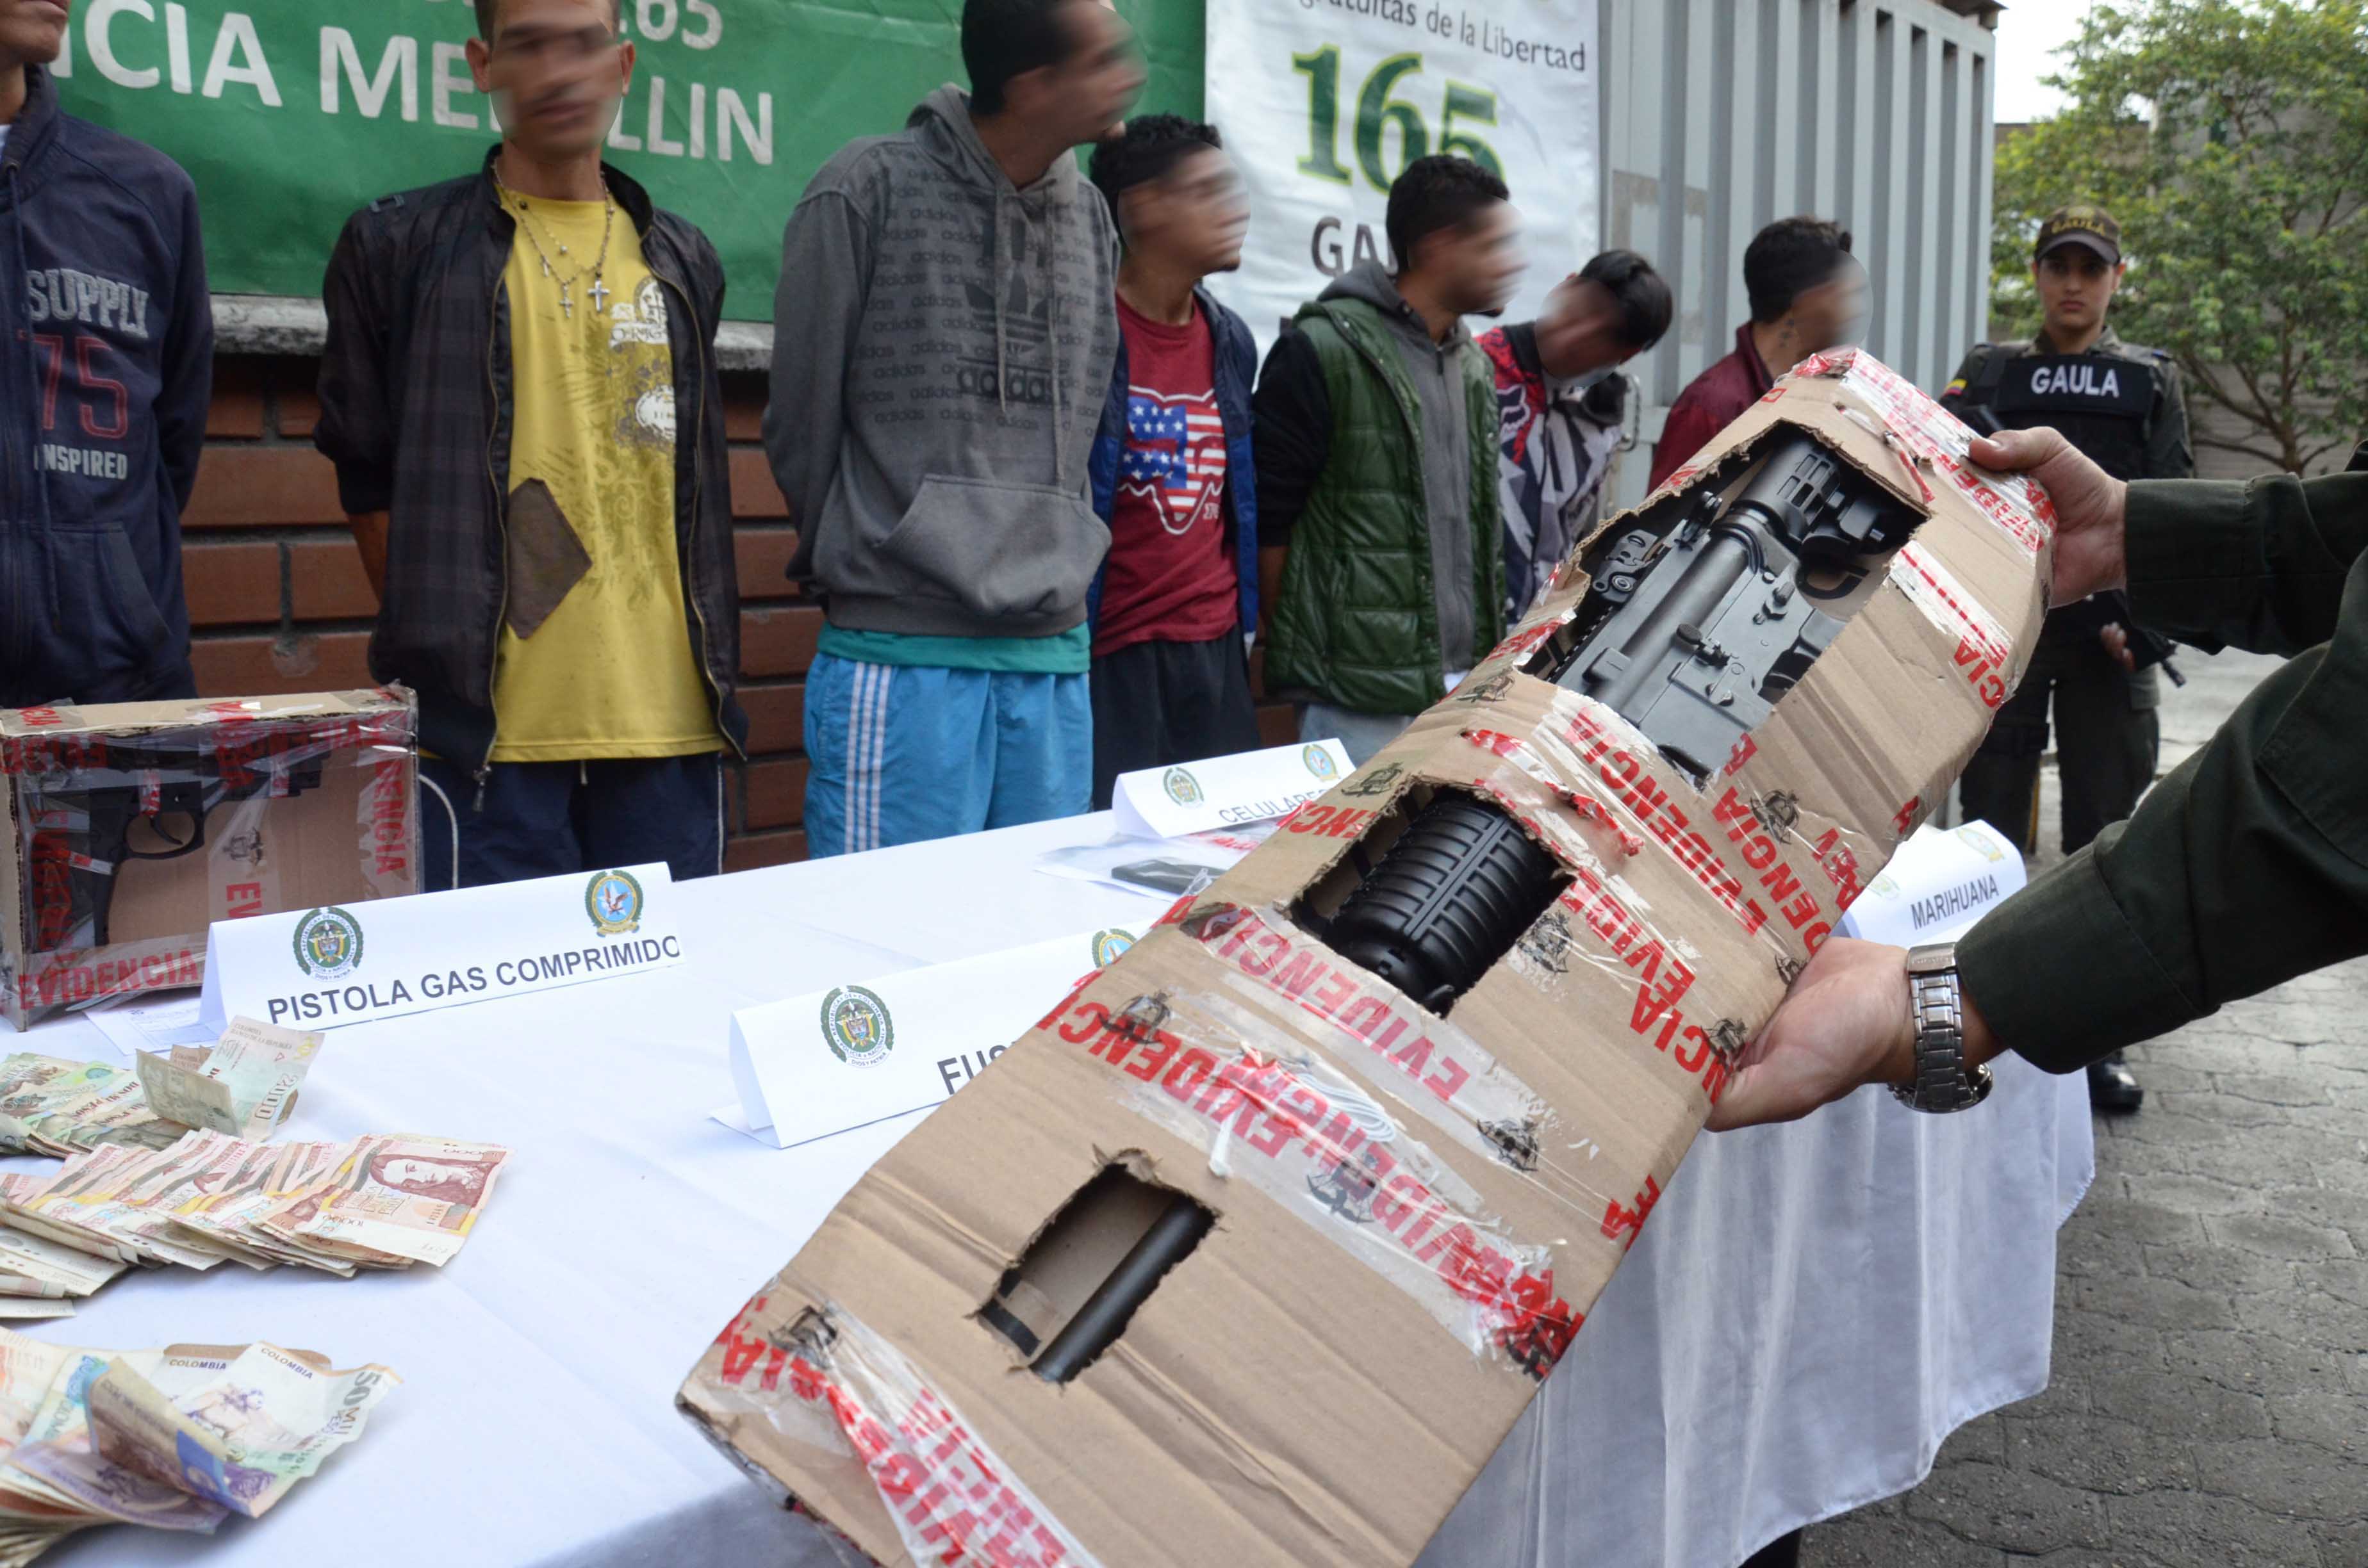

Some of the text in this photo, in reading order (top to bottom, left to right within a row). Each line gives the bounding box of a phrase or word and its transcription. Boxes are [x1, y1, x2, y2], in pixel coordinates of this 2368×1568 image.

[1426, 8, 1452, 38] de
[1460, 11, 1475, 47] la
[1483, 20, 1586, 72] Libertad
[26, 268, 149, 339] SUPPLY
[17, 329, 129, 439] 75
[2030, 364, 2119, 398] GAULA
[1911, 874, 2000, 930] MARIHUANA
[18, 950, 197, 1011] EVIDENCIA
[267, 980, 413, 1024] PISTOLA
[422, 967, 488, 999] GAS
[169, 1358, 227, 1371] COLOMBIA
[261, 1346, 313, 1380] COLOMBIA
